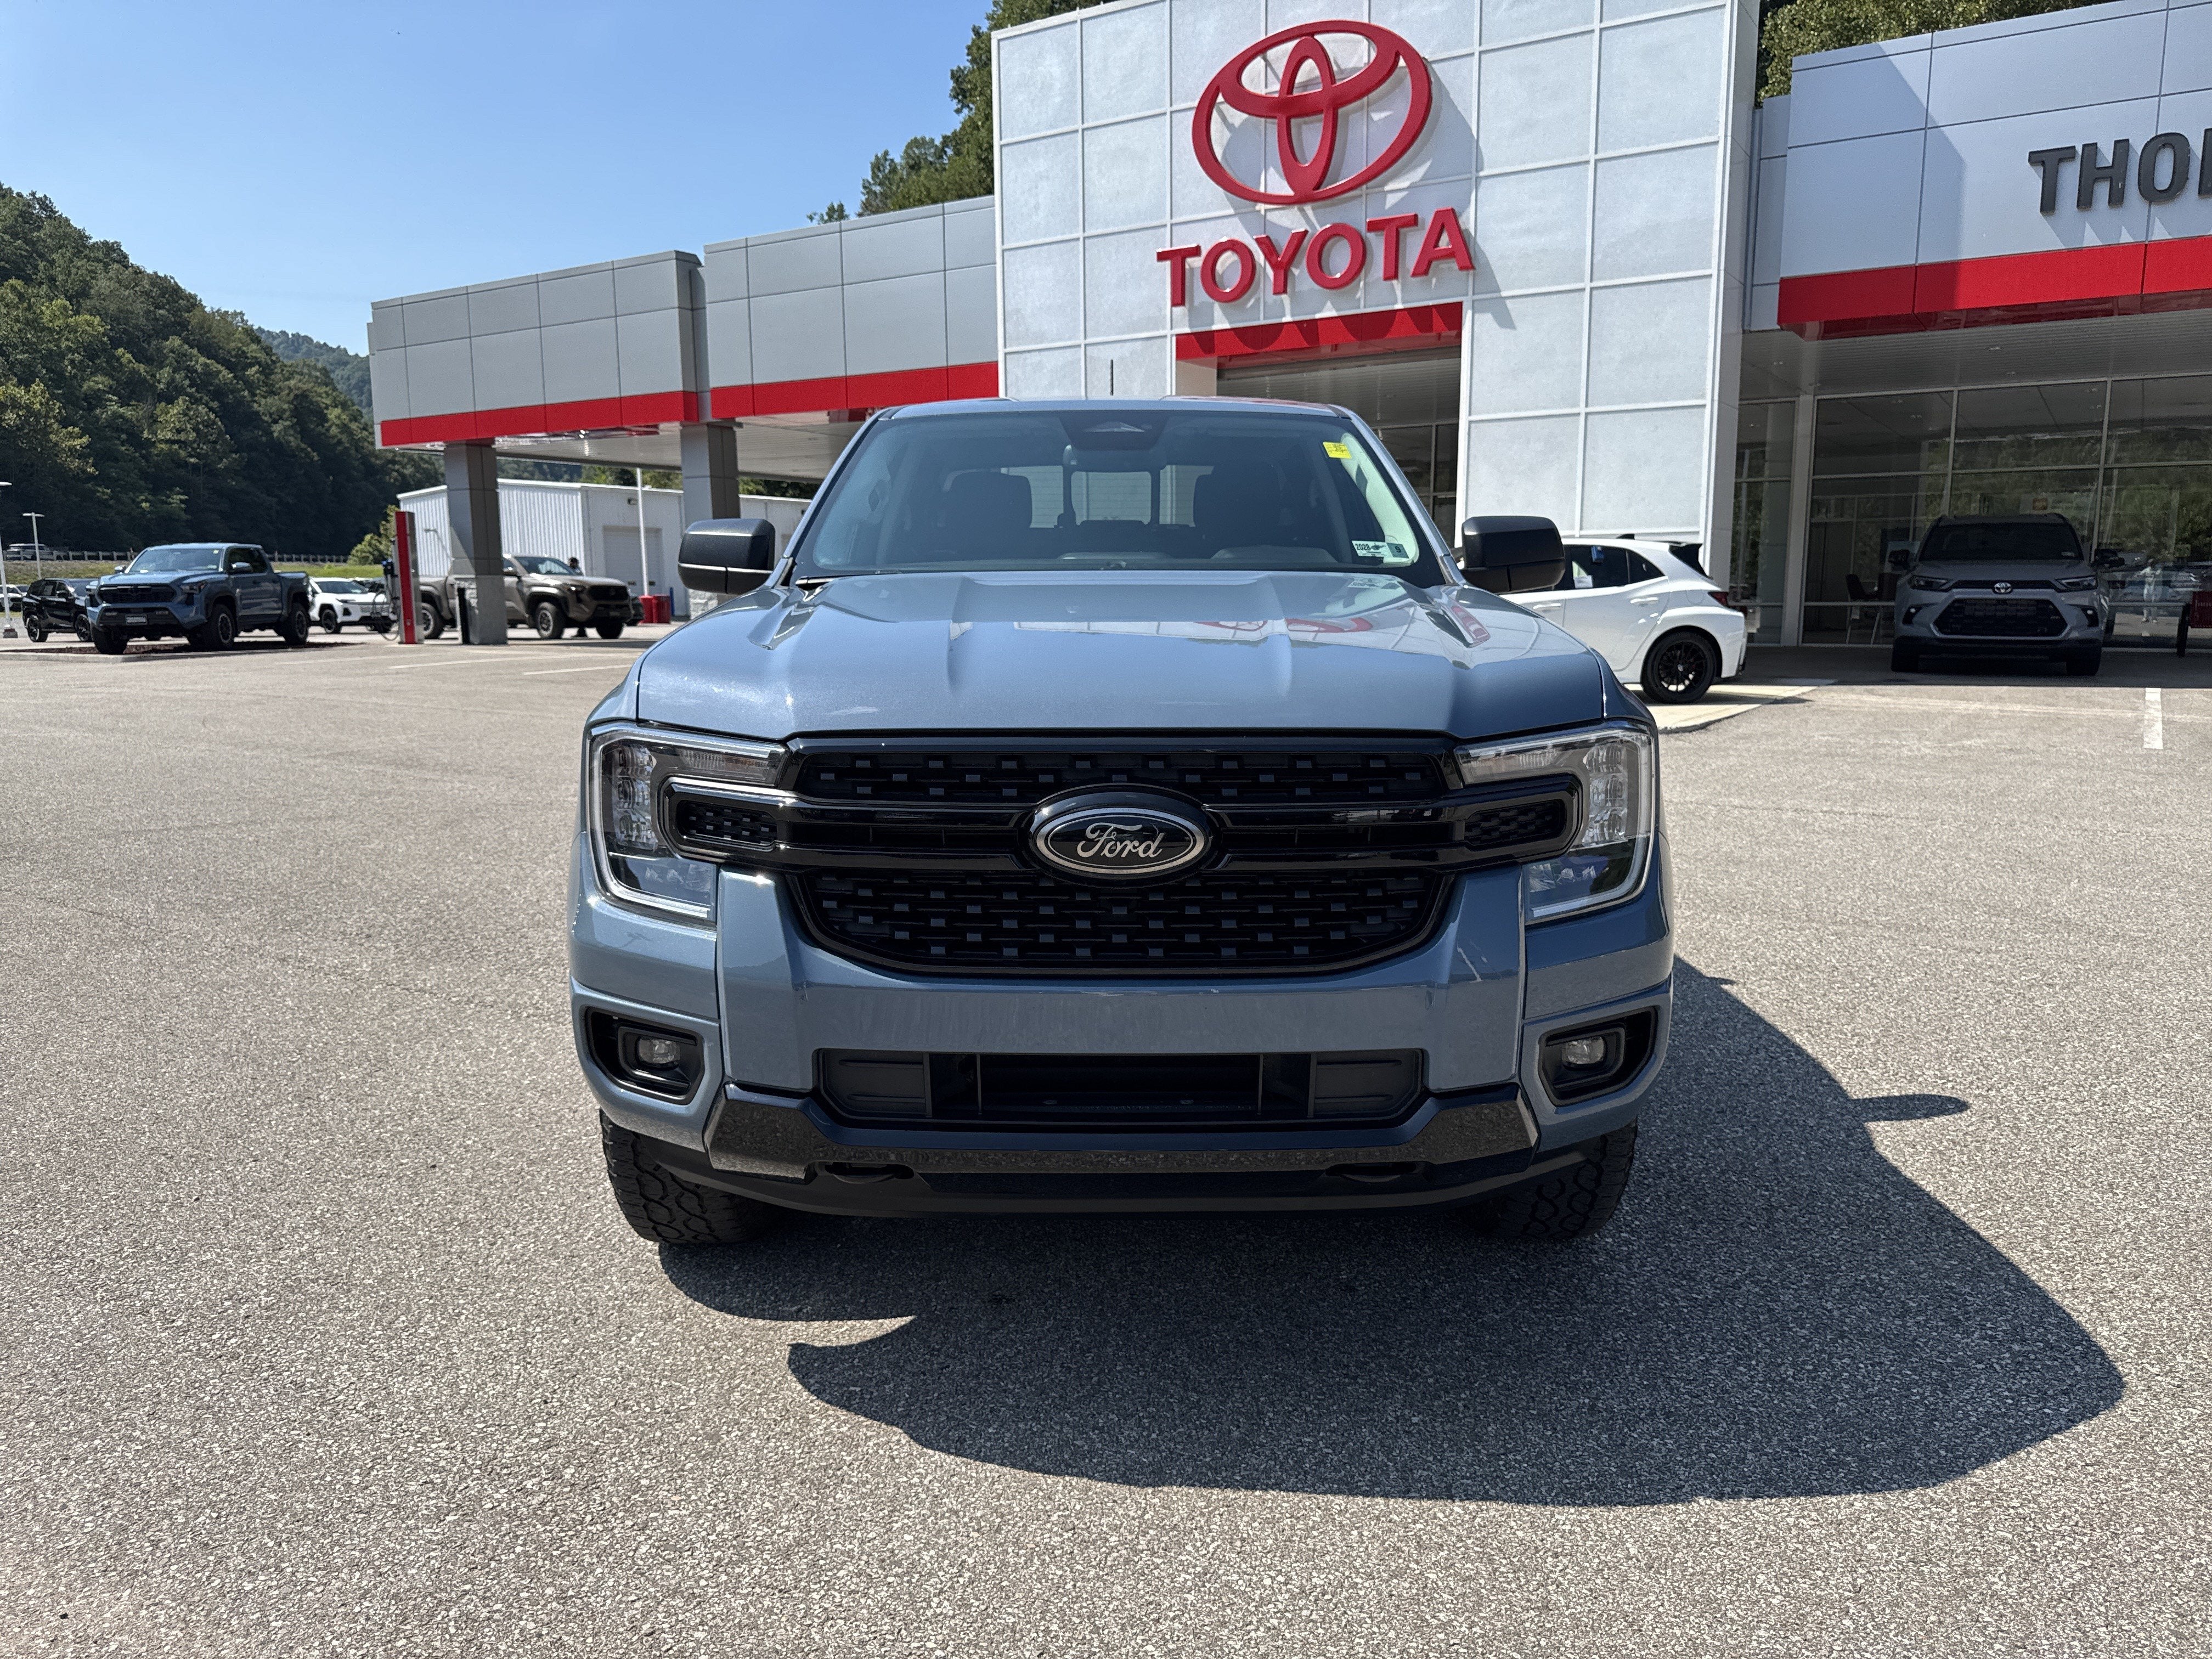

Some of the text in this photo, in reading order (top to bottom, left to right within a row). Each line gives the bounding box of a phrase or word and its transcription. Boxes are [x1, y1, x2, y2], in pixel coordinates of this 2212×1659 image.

[2028, 128, 2212, 215] THO
[1156, 207, 1475, 307] TOYOTA
[1077, 822, 1165, 857] Ford
